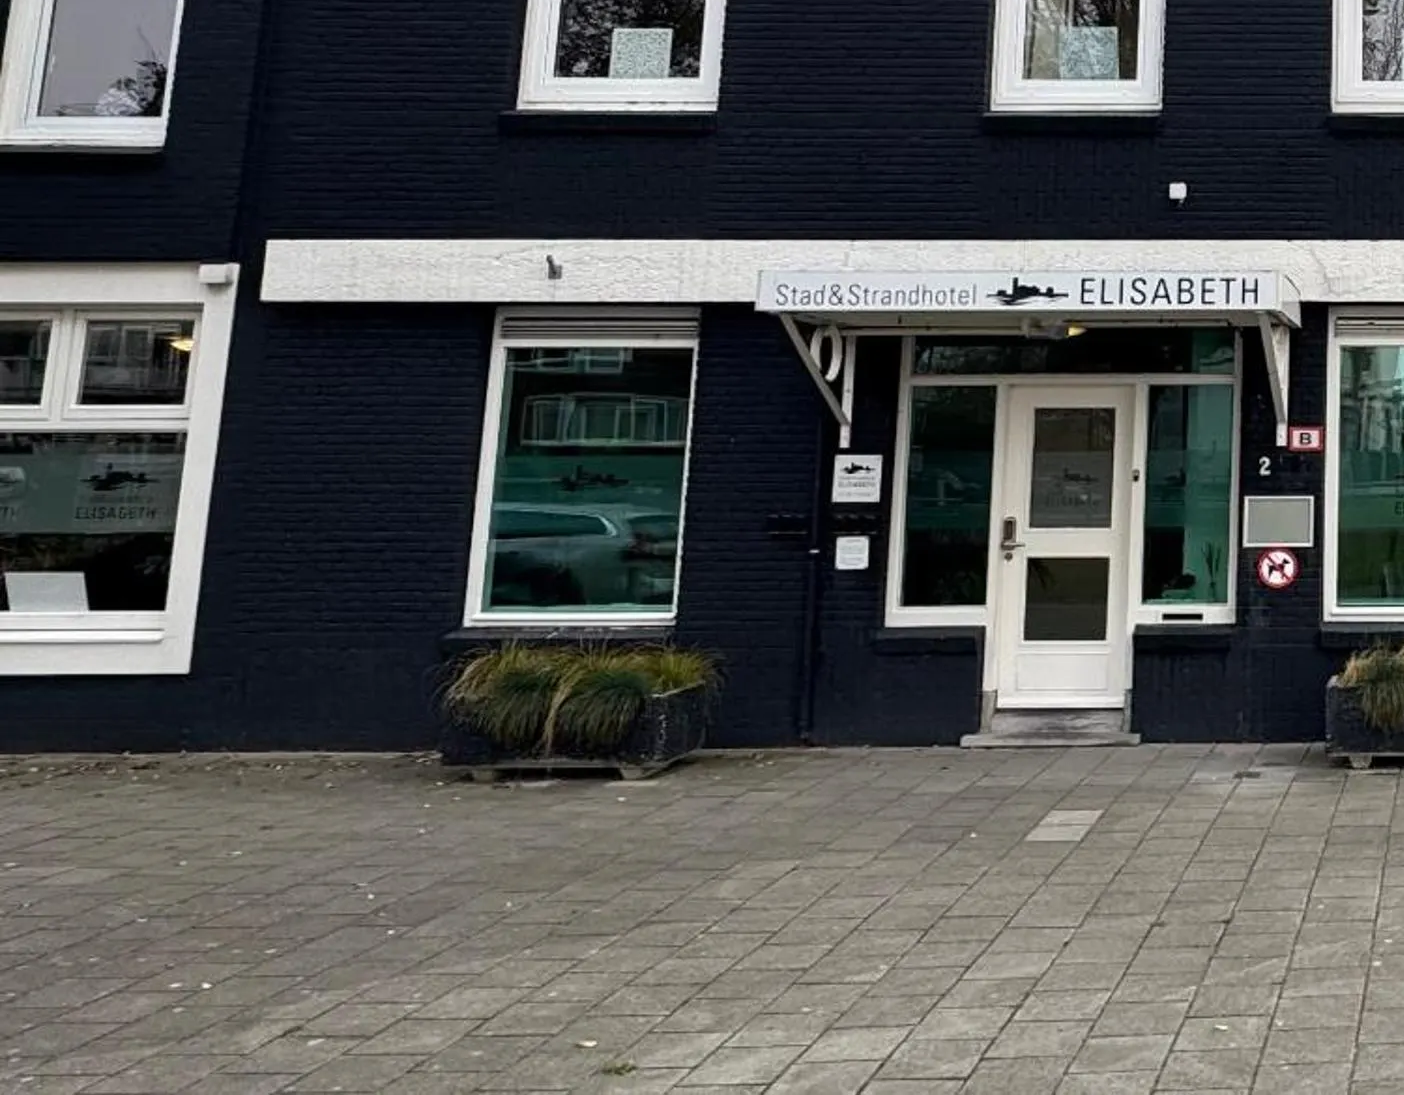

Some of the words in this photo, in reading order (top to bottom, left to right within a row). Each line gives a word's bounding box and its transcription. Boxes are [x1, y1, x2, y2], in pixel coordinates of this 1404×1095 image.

[774, 282, 978, 307] Stad&Strandhotel
[1079, 277, 1260, 306] ELISABETH
[1300, 432, 1313, 445] B
[1258, 456, 1271, 476] 2
